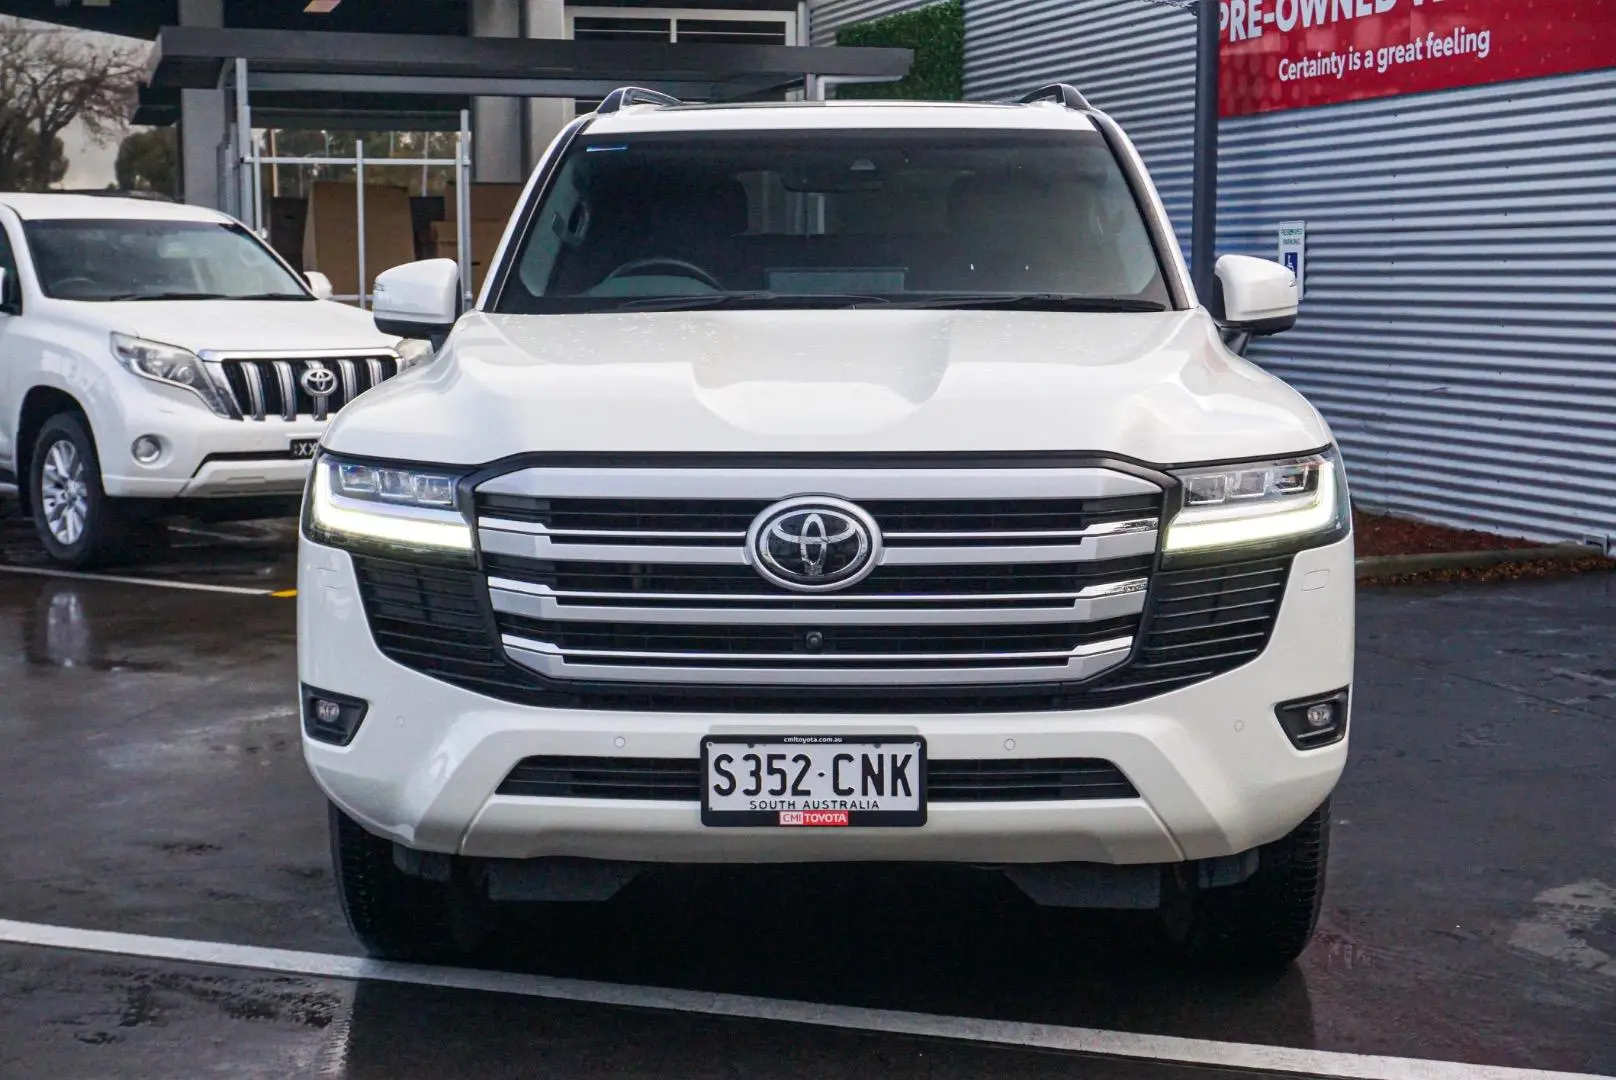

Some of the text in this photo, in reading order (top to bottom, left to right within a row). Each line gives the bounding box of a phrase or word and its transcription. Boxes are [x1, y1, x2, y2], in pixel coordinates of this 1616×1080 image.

[1278, 27, 1491, 82] Certainty is a great feeling
[749, 800, 880, 810] SOUTH AUSTRALIA
[782, 813, 847, 823] CMI TOYOTA
